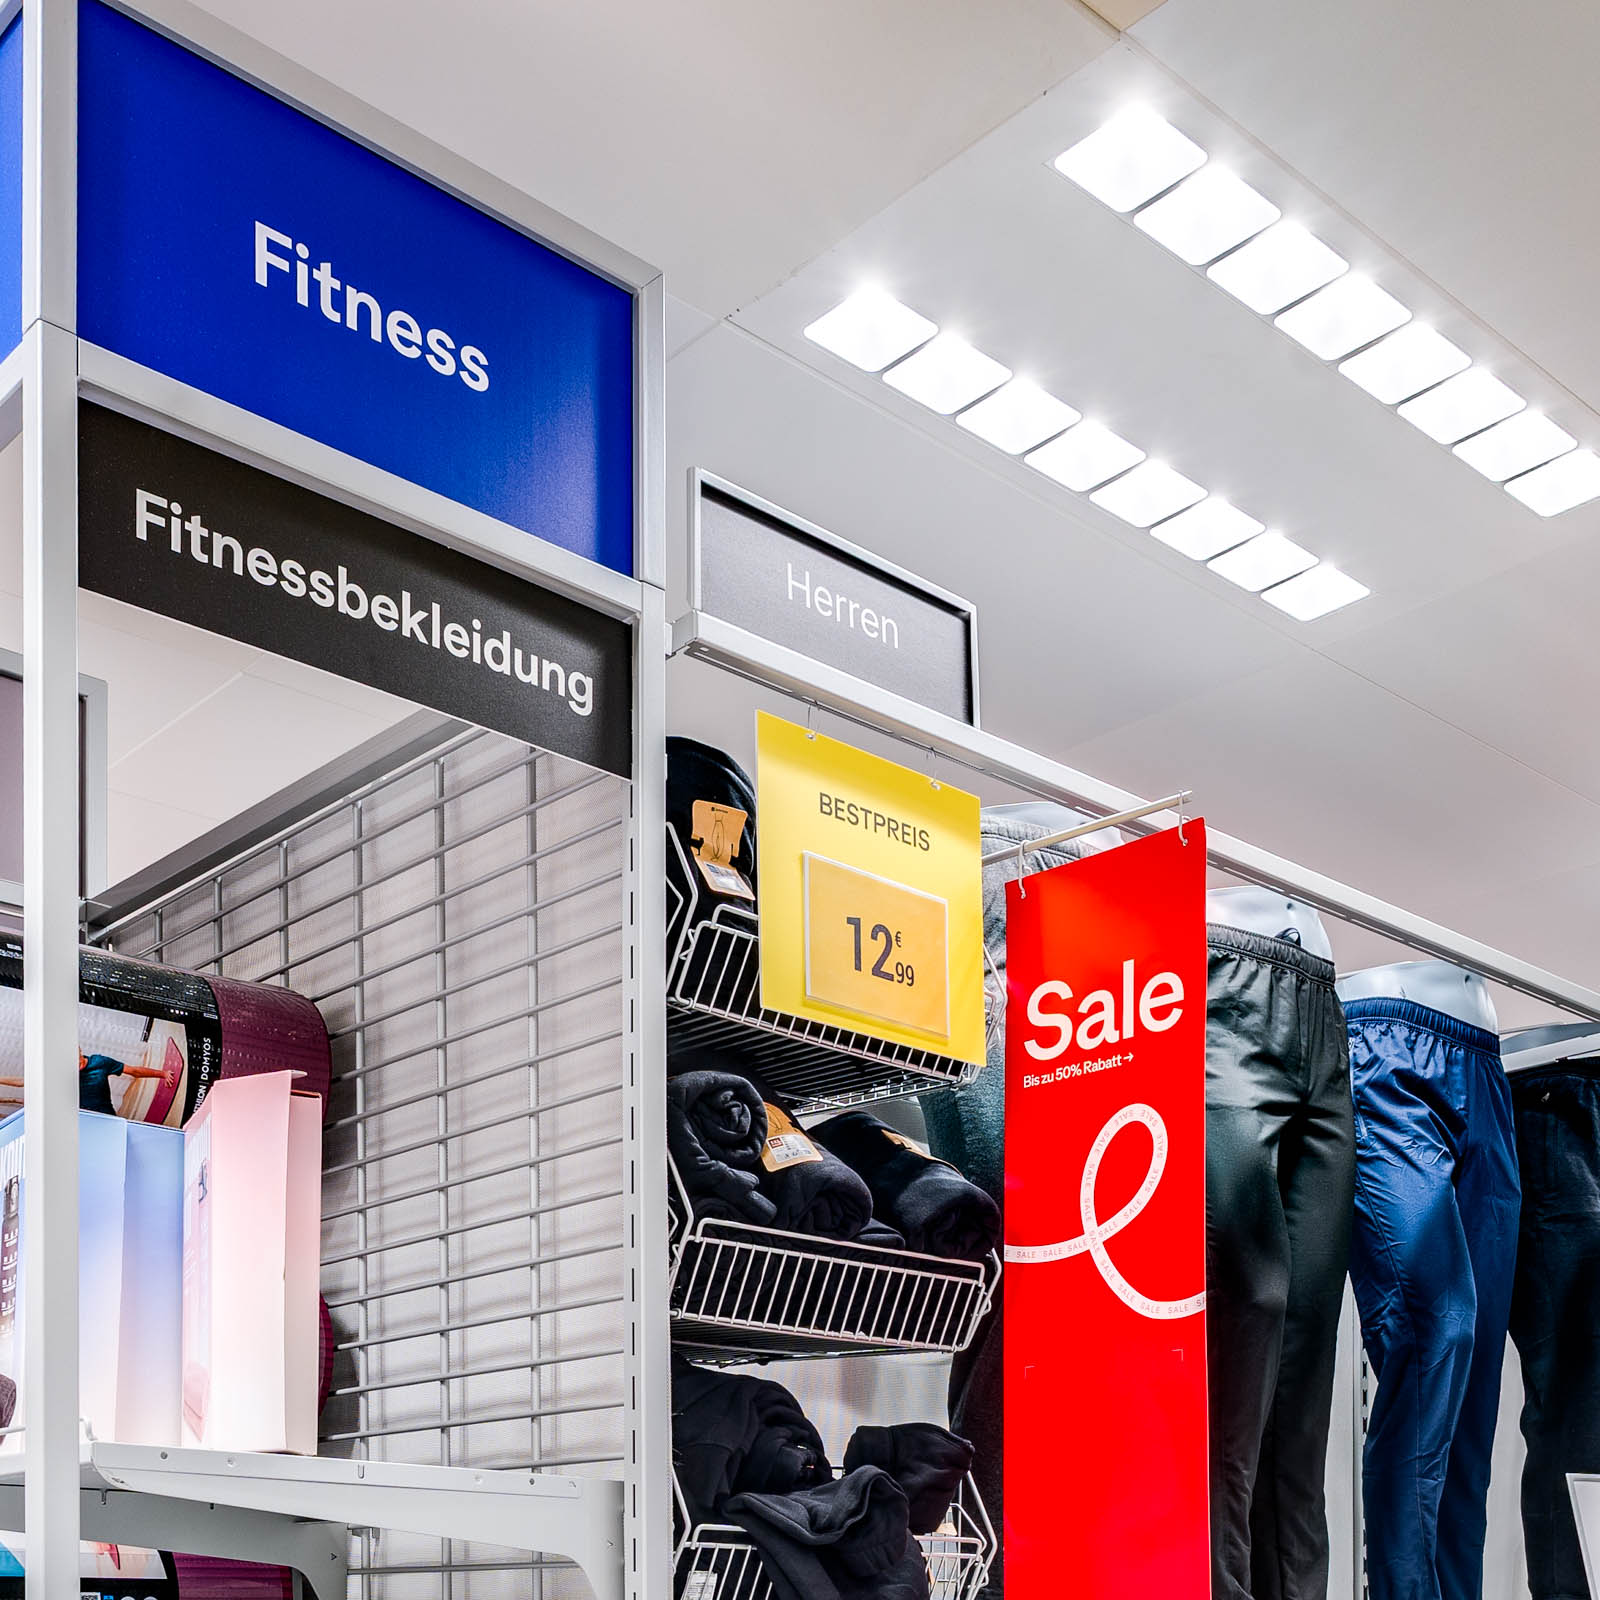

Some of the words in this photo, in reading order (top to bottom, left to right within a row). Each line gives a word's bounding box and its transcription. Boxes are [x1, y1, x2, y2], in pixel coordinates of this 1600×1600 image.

[253, 219, 490, 393] Fitness
[134, 487, 595, 717] Fitnessbekleidung
[787, 562, 899, 649] Herren
[818, 791, 931, 853] BESTPREIS
[846, 916, 894, 984] 12
[894, 960, 915, 988] 99
[1023, 959, 1185, 1061] Sale
[200, 1037, 212, 1081] DOMYOS
[1023, 1074, 1040, 1089] Bis
[1040, 1072, 1055, 1085] zu
[1055, 1063, 1082, 1081] 50%
[1083, 1053, 1123, 1075] Rabatt
